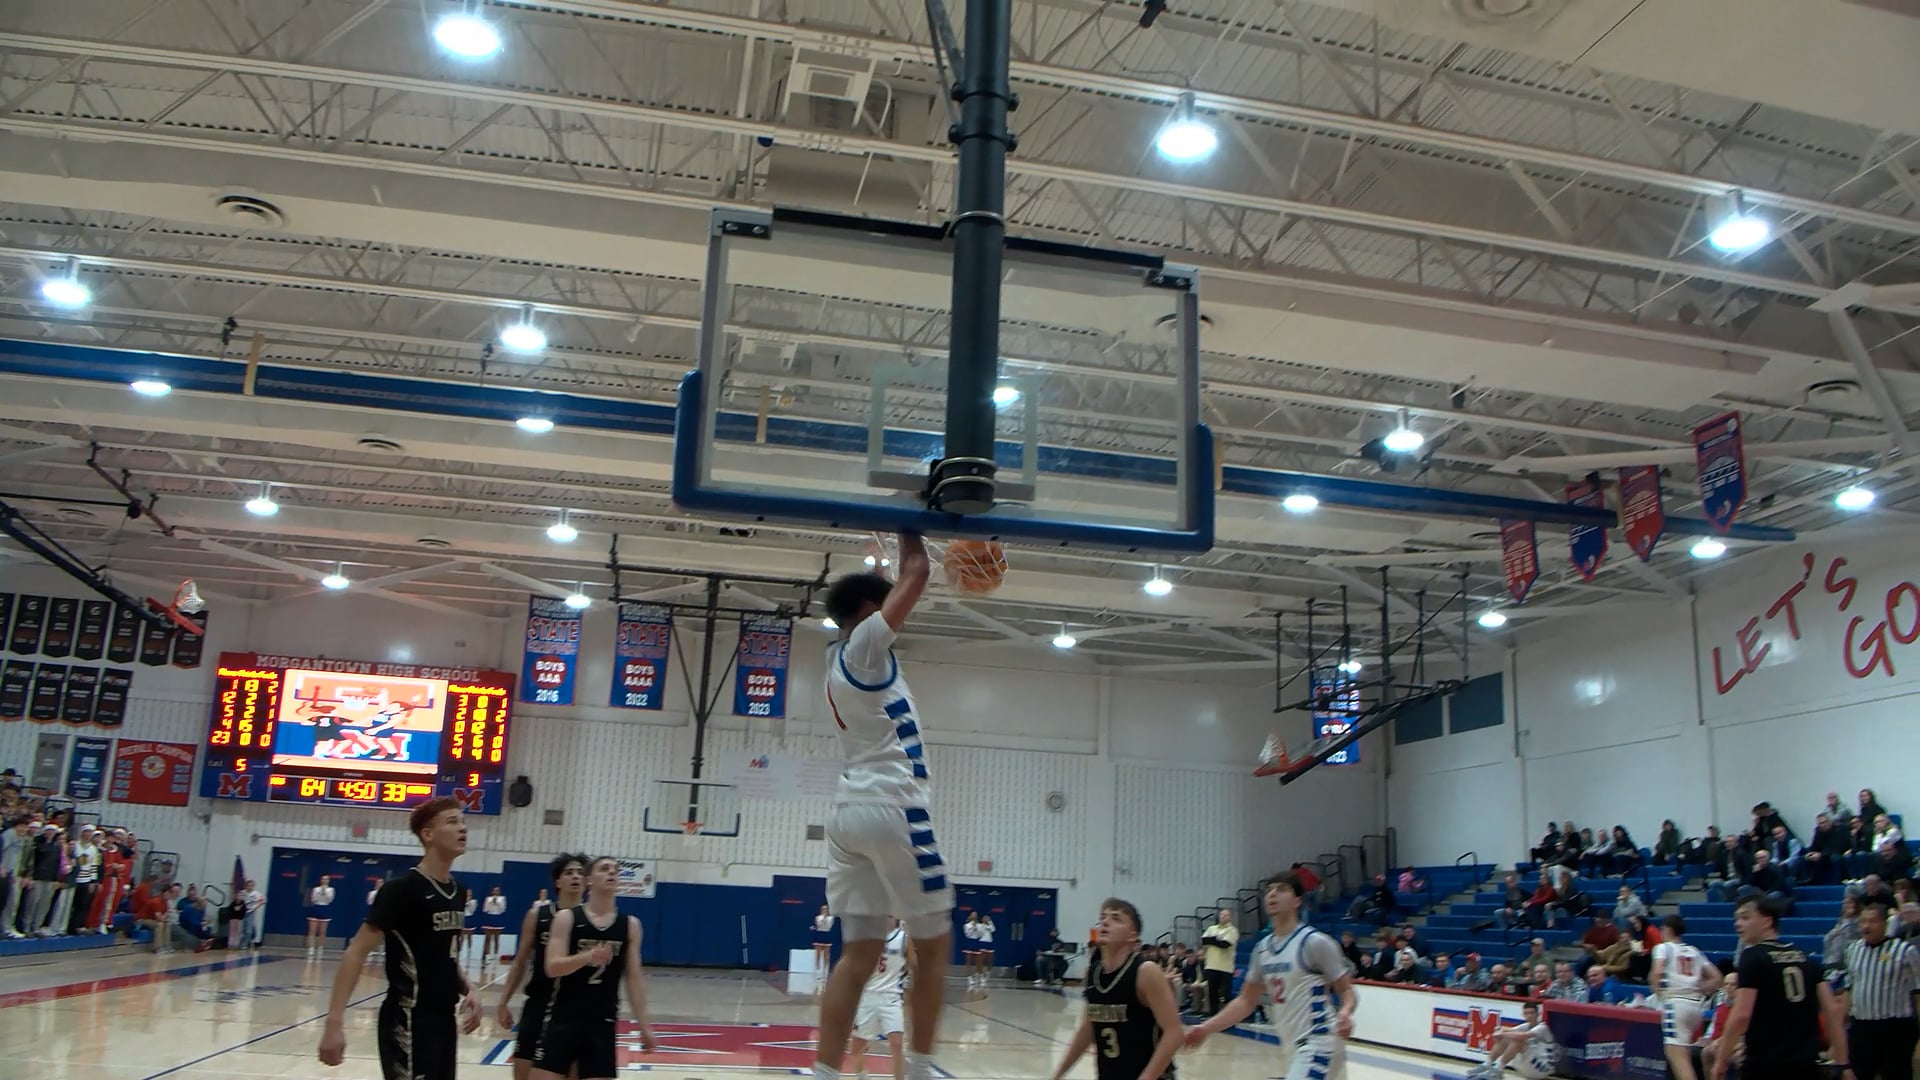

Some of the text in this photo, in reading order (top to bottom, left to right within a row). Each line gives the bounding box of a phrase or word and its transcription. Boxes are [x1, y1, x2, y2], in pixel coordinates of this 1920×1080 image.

[528, 616, 581, 642] STATE
[1713, 552, 1858, 695] LET'S
[1843, 581, 1920, 678] GO
[619, 622, 669, 646] STATE
[740, 632, 790, 657] STATE
[256, 655, 481, 682] MORGANTOWN HIGH SCHOOL
[535, 661, 566, 672] BOYS
[625, 664, 655, 675] BOYS
[537, 673, 561, 684] AAA
[624, 676, 653, 687] AAAA
[748, 675, 776, 685] BOYS
[267, 681, 279, 693] 2
[746, 686, 775, 697] AAAA
[245, 692, 257, 705] 2
[458, 694, 469, 707] 3
[625, 693, 648, 706] 2022
[223, 704, 234, 717] 5
[243, 705, 255, 718] 2
[456, 707, 467, 720] 2
[495, 709, 506, 723] 2
[748, 702, 770, 715] 2023
[222, 718, 232, 730] 4
[454, 720, 466, 733] 0
[211, 730, 271, 747] 23 0 0
[453, 733, 464, 746] 5
[451, 747, 463, 759] 4
[235, 758, 247, 772] 5
[216, 772, 254, 798] M
[468, 773, 479, 787] 3
[300, 778, 326, 797] 64
[382, 783, 406, 802] 33
[1782, 965, 1807, 1003] 0
[1466, 1005, 1503, 1054] M
[1101, 1026, 1121, 1059] 3
